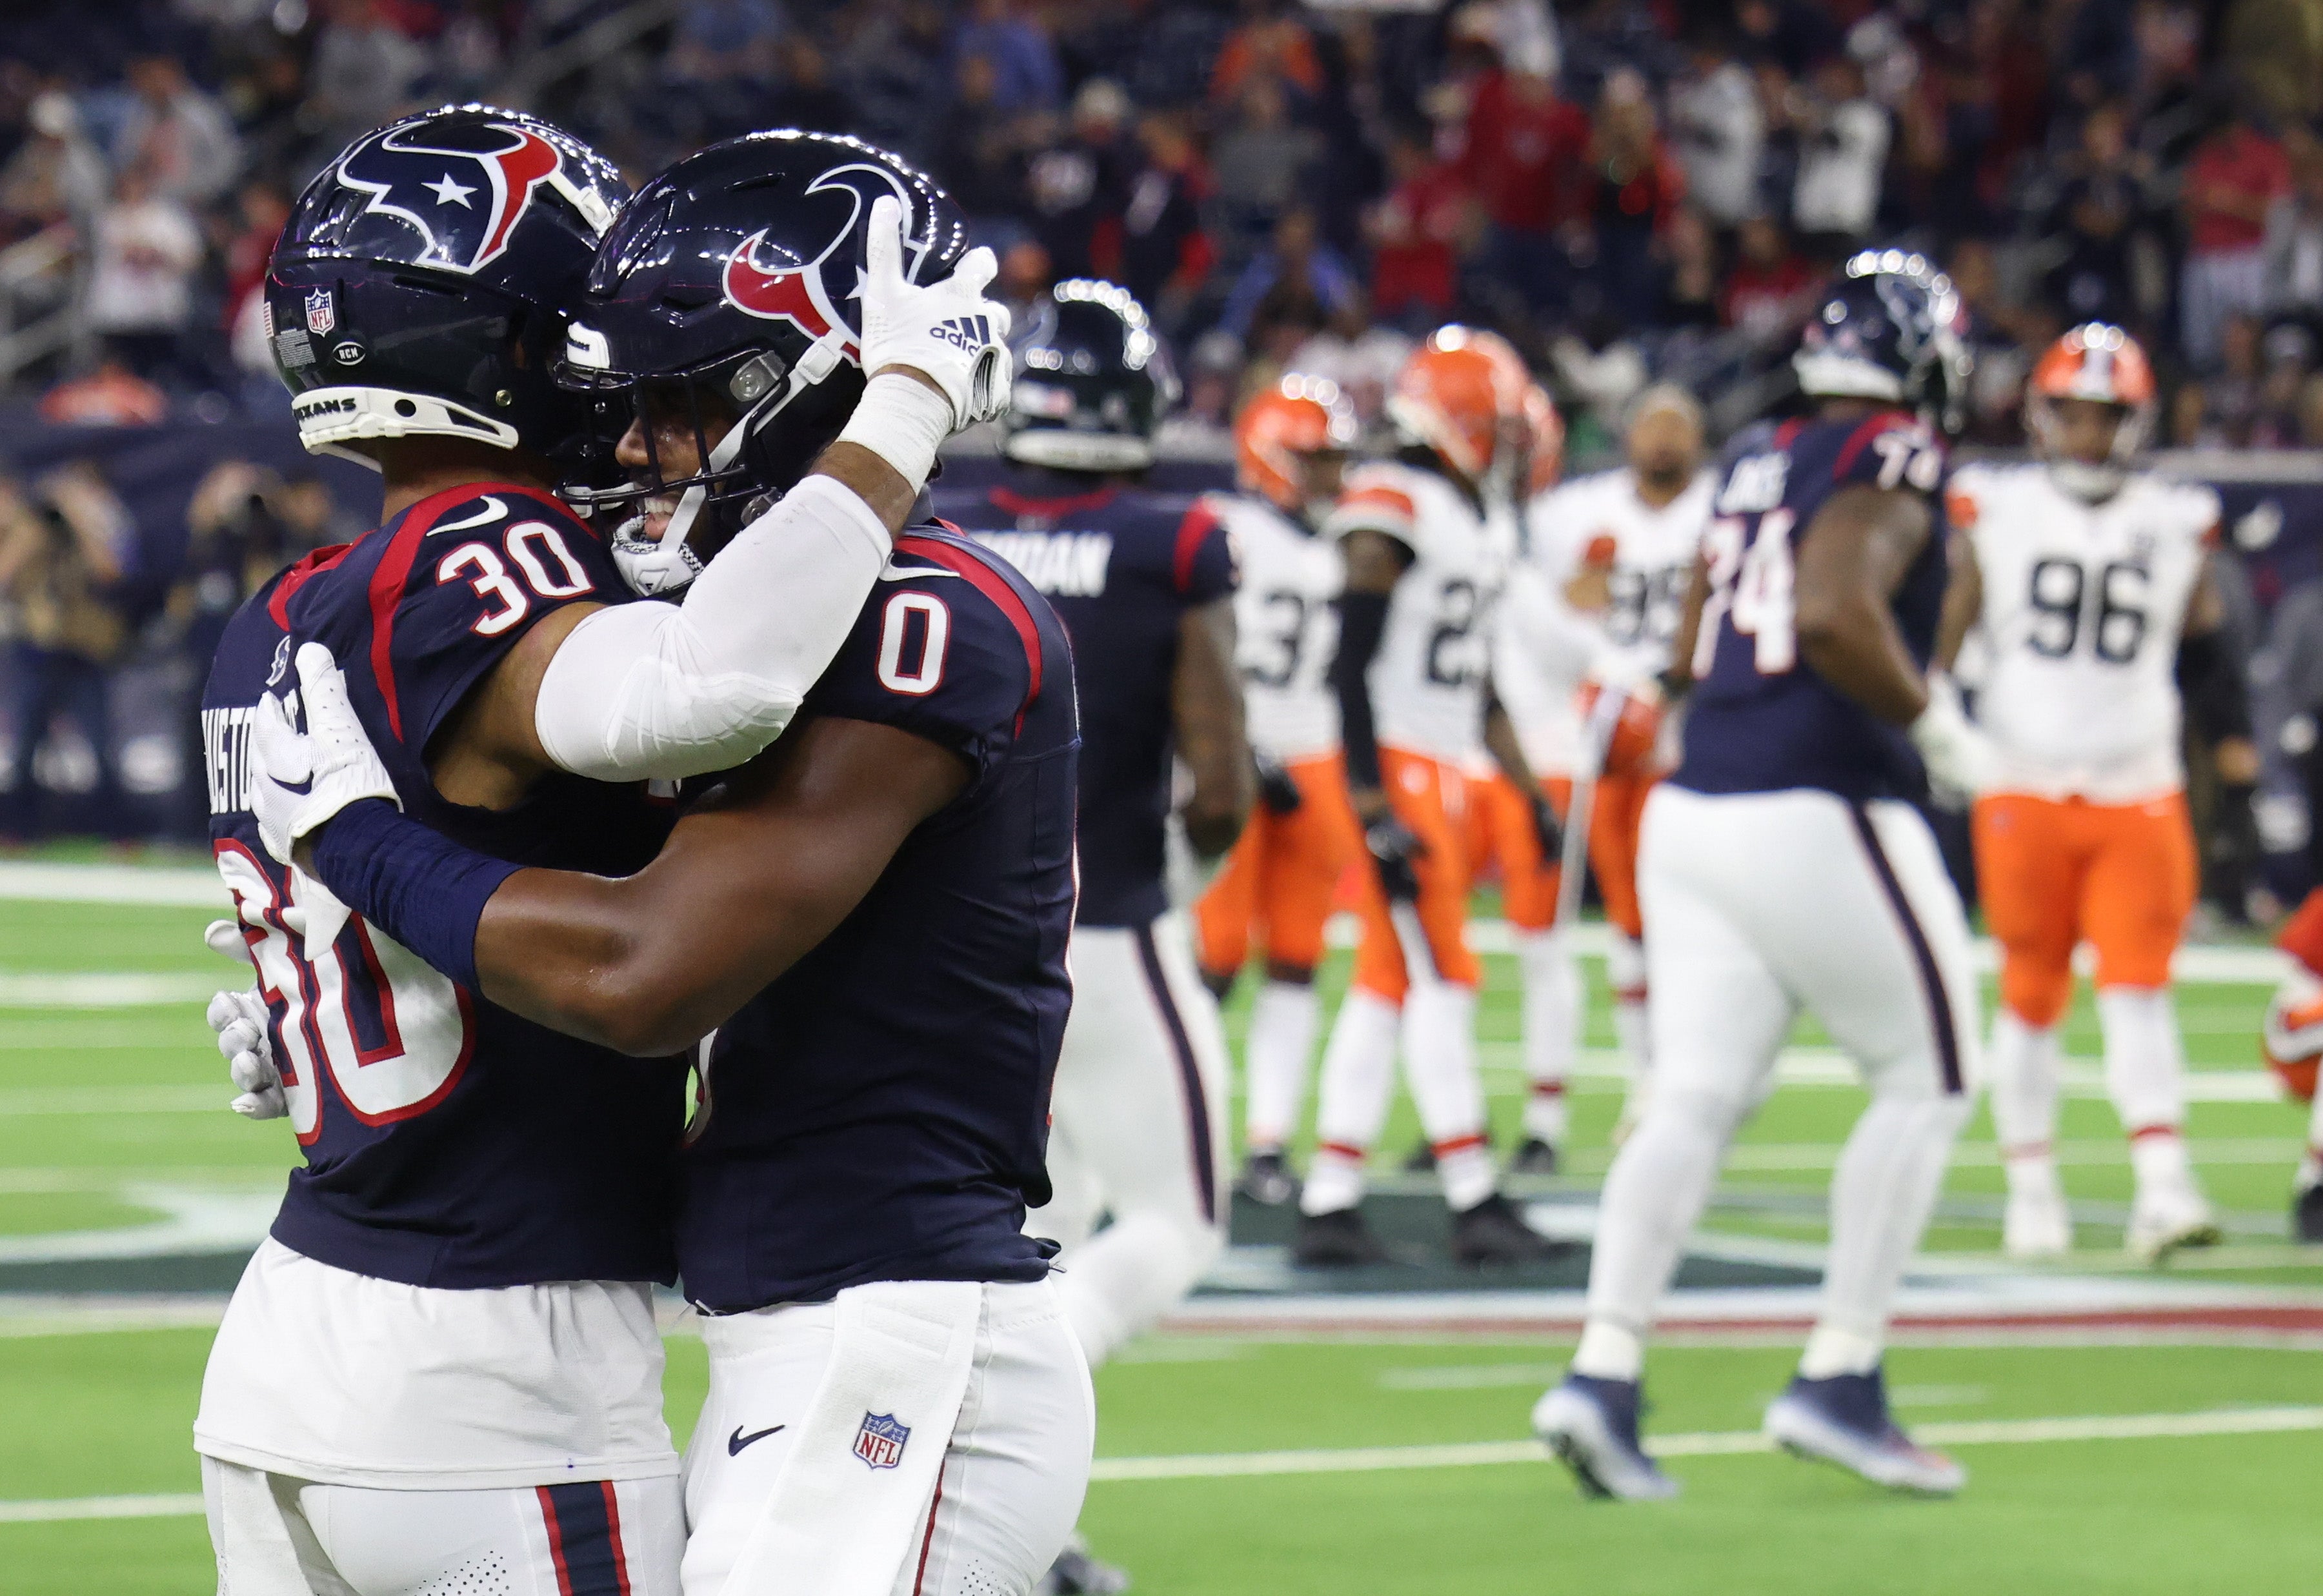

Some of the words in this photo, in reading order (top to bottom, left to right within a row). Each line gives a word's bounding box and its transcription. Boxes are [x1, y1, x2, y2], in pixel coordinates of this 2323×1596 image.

[310, 309, 331, 329] NFL
[435, 525, 596, 637] 30
[2026, 555, 2151, 664] 96
[874, 590, 952, 697] 0
[858, 1431, 896, 1464] NFL
